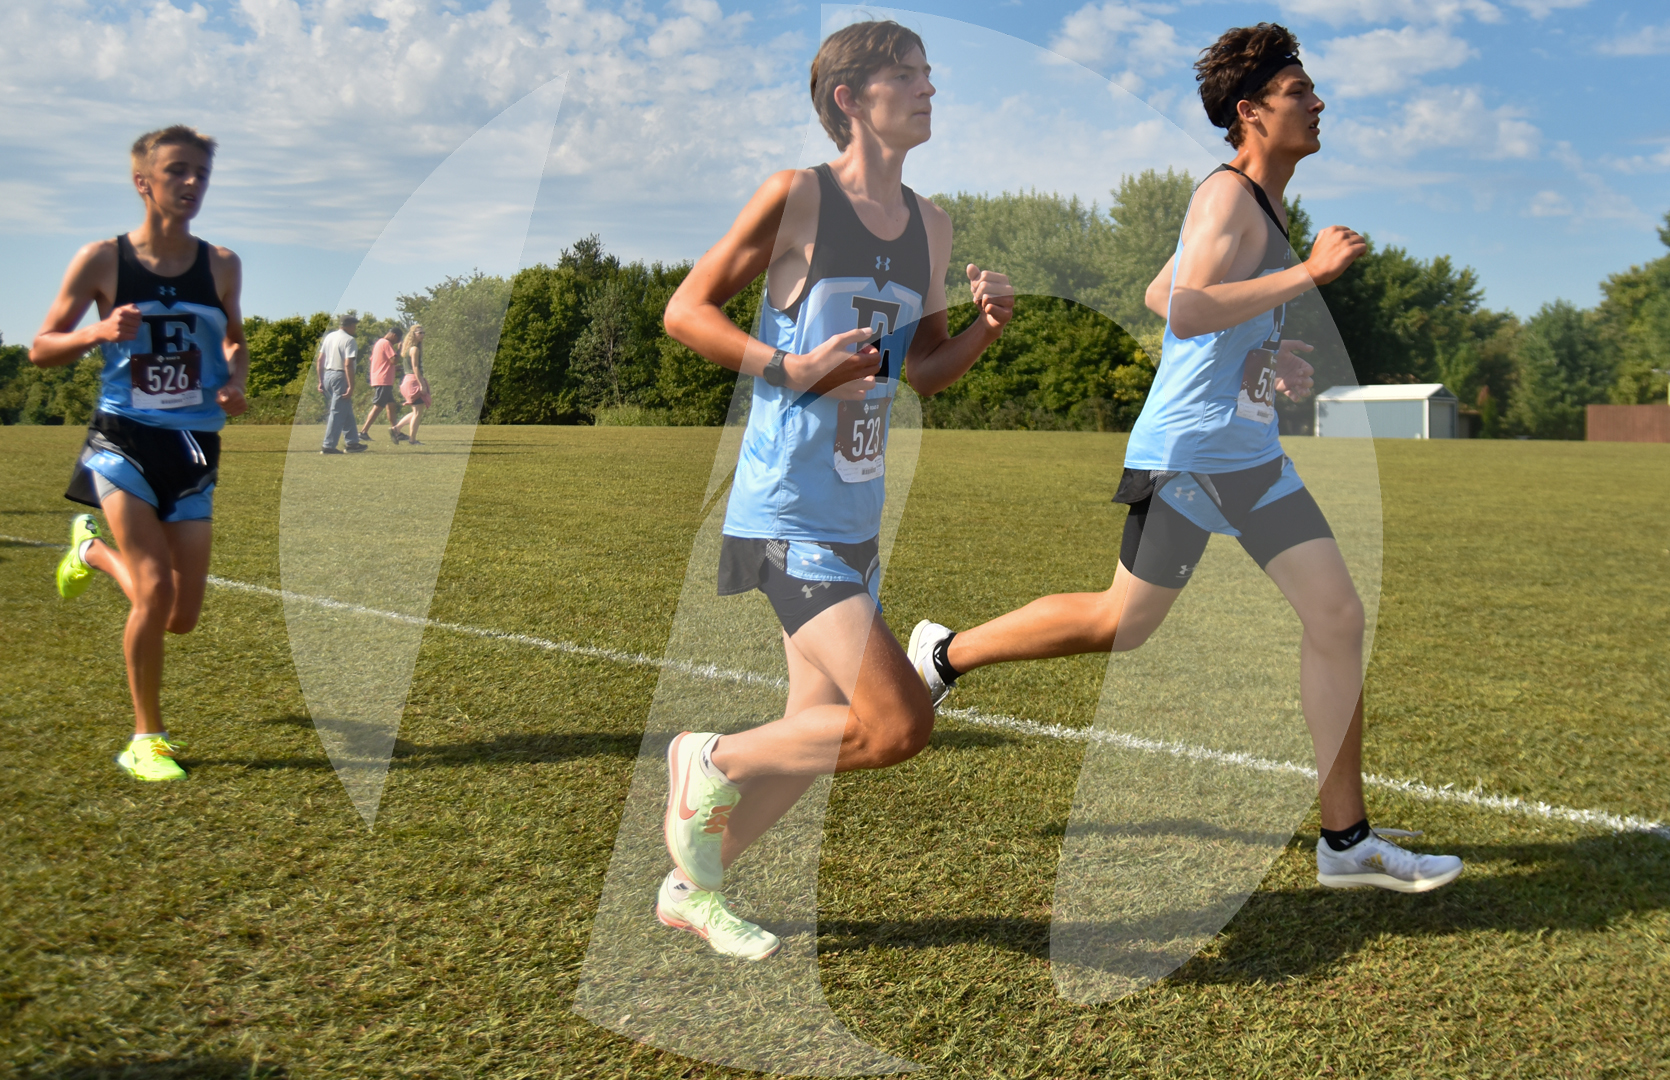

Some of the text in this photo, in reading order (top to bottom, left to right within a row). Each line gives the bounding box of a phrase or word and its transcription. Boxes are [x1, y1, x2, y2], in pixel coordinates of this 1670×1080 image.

[141, 313, 198, 353] E
[852, 295, 901, 385] E
[147, 364, 189, 392] 526
[851, 416, 881, 457] 523
